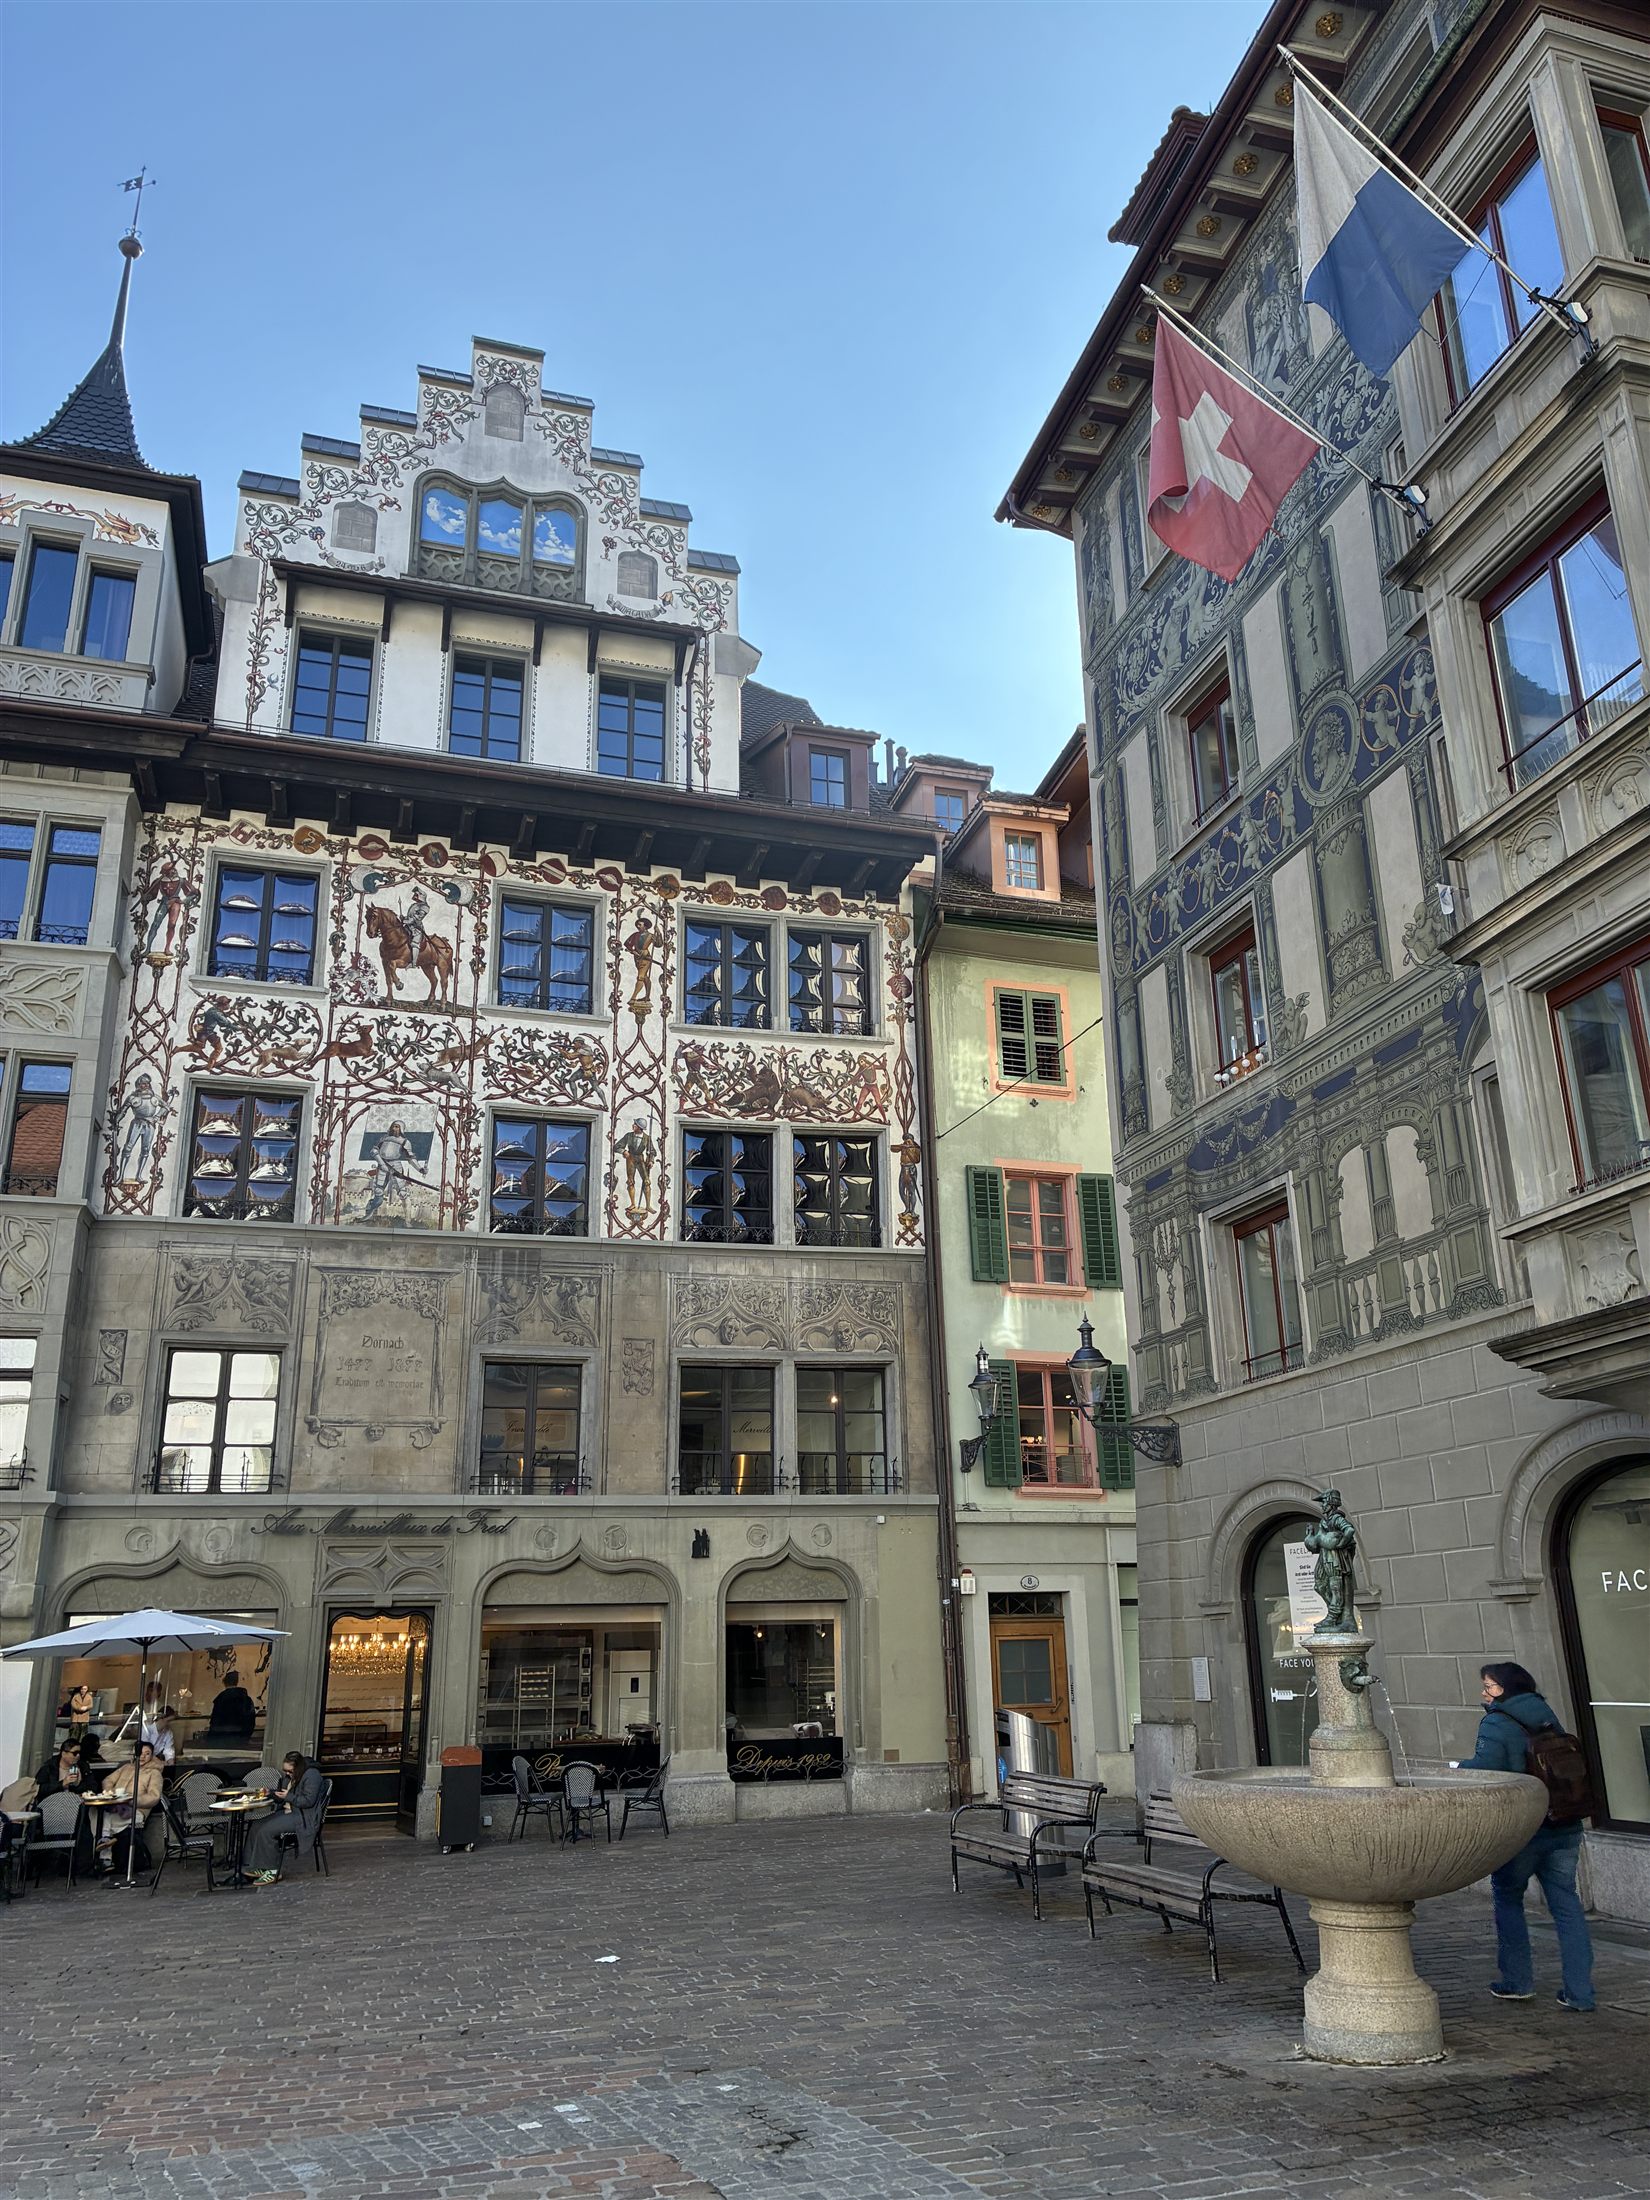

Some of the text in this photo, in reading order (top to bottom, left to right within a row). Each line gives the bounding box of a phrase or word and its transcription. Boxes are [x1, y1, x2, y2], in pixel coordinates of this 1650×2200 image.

[361, 1335, 405, 1350] Dornach
[250, 1506, 518, 1535] Aux Merveilleux de Fred
[1027, 1577, 1033, 1585] 8
[1601, 1569, 1648, 1593] FAC
[1279, 1659, 1298, 1668] FACE
[736, 1745, 831, 1776] Depuis 1982
